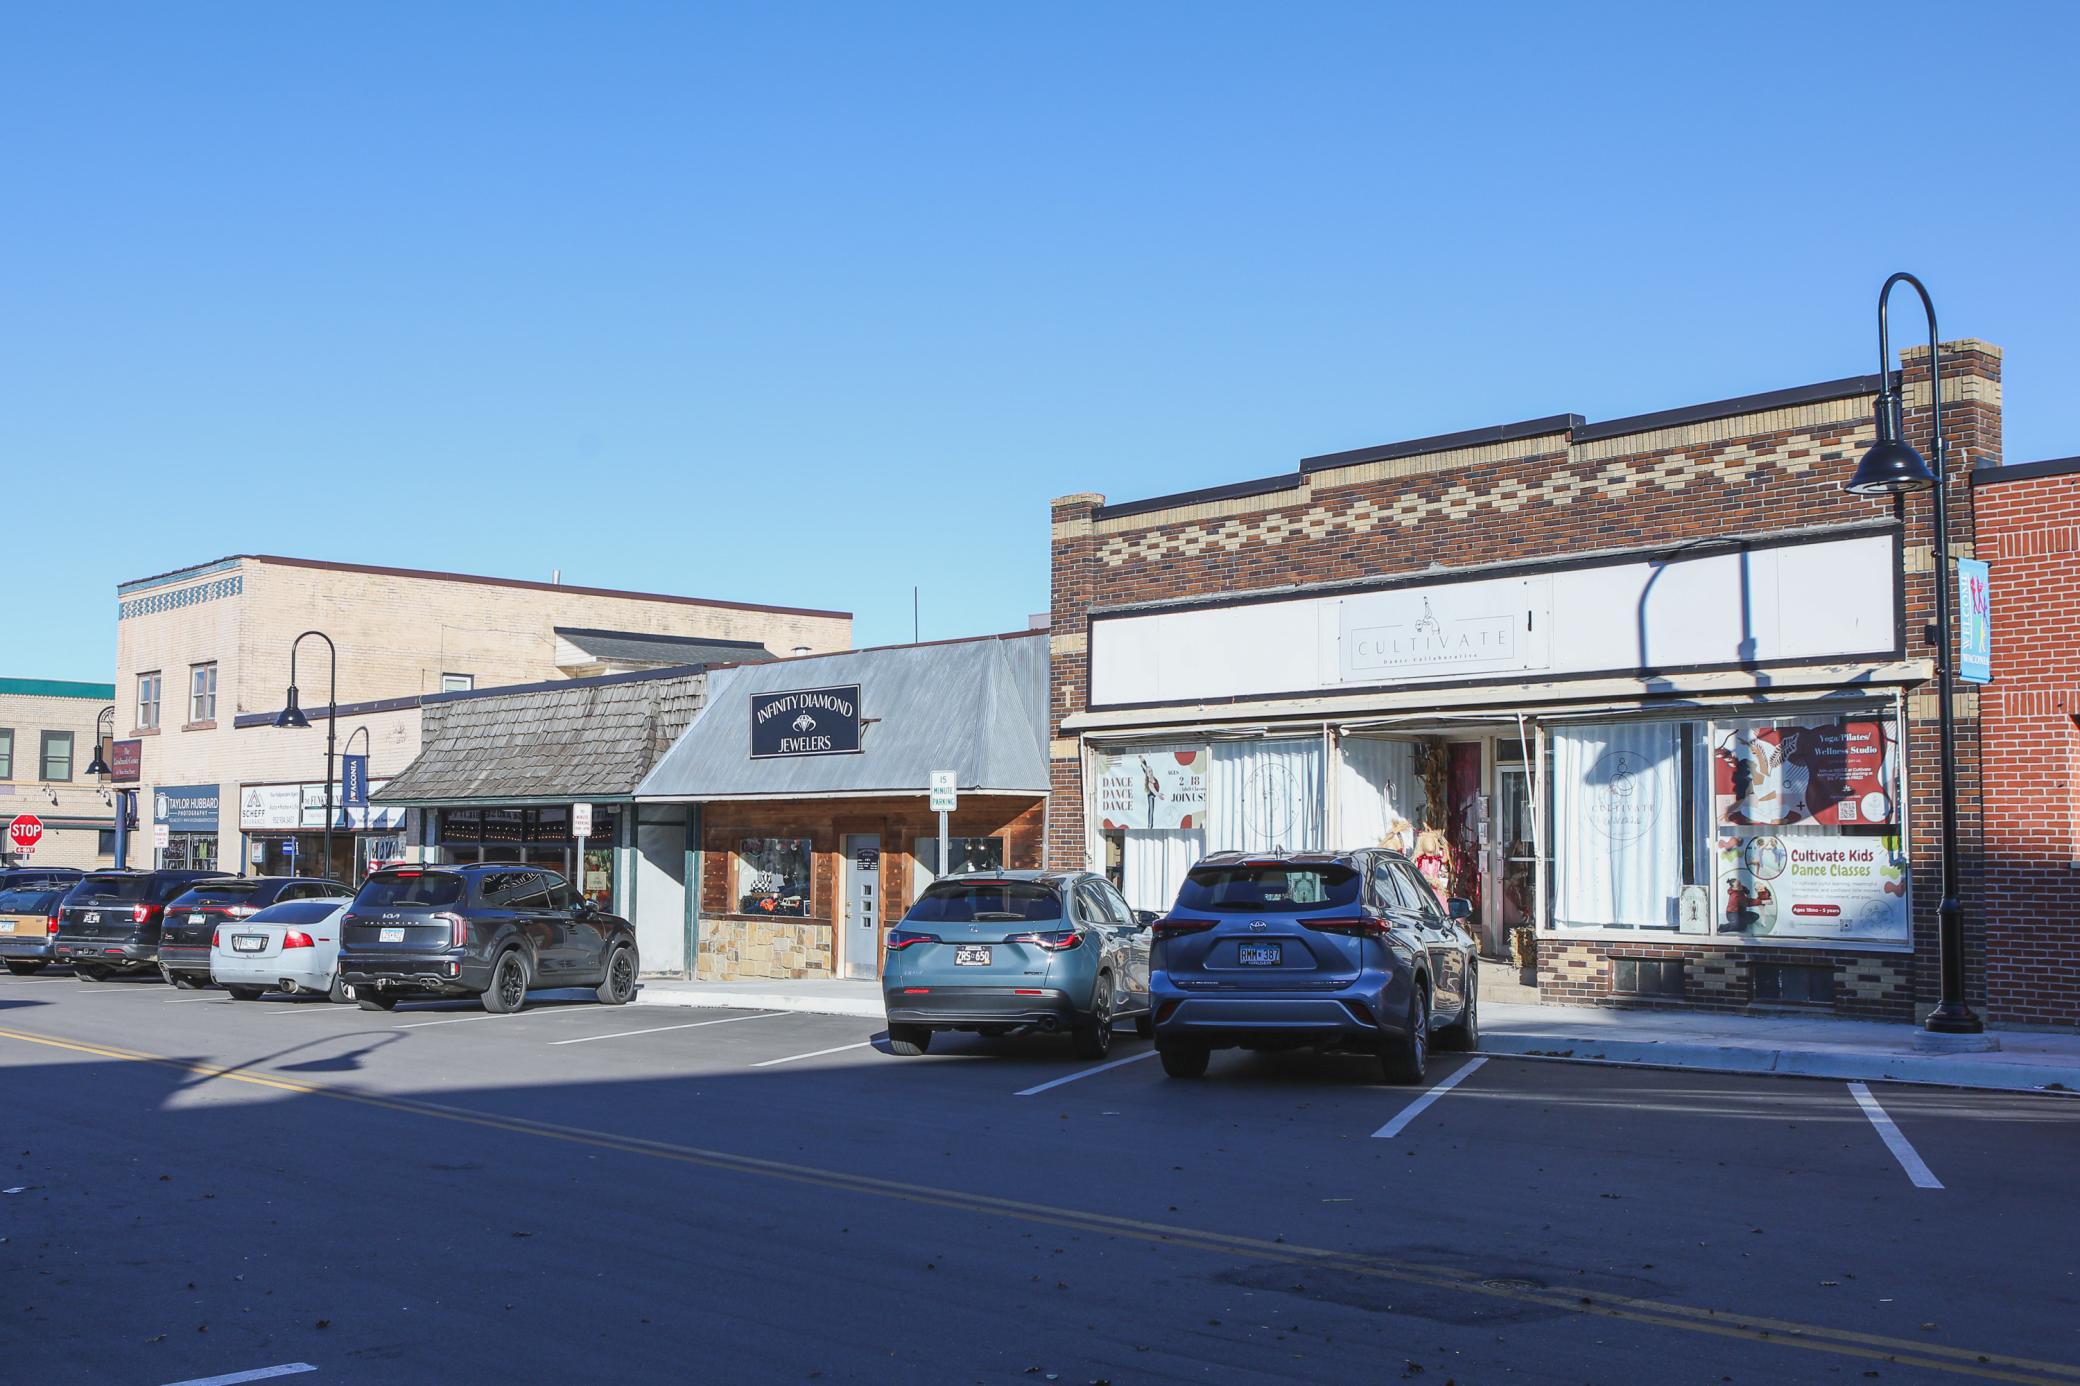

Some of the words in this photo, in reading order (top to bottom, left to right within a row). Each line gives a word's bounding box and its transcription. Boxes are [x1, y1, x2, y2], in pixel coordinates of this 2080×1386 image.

[1358, 631, 1506, 655] CULTIVATE
[757, 695, 799, 724] INFINITY
[800, 693, 853, 718] DIAMOND
[778, 735, 832, 753] JEWELERS
[1850, 745, 1878, 755] Studio
[940, 775, 947, 784] 15
[1102, 776, 1134, 788] DANCE
[1179, 777, 1185, 786] 2
[1190, 775, 1201, 786] 18
[933, 786, 953, 795] MINUTE
[1102, 788, 1134, 799] DANCE
[169, 799, 189, 809] TAYLOR
[190, 797, 218, 809] HUBBARD
[932, 798, 953, 806] PARKING
[1170, 792, 1191, 803] JOIN
[1102, 800, 1134, 811] DANCE
[242, 809, 265, 818] SCHEFF
[11, 824, 41, 837] STOP
[1791, 849, 1846, 862] Cultivate
[1849, 849, 1874, 862] Kids
[1791, 864, 1827, 876] Dance
[1830, 864, 1871, 876] Classes
[956, 950, 971, 960] ZRS
[976, 950, 990, 961] 650
